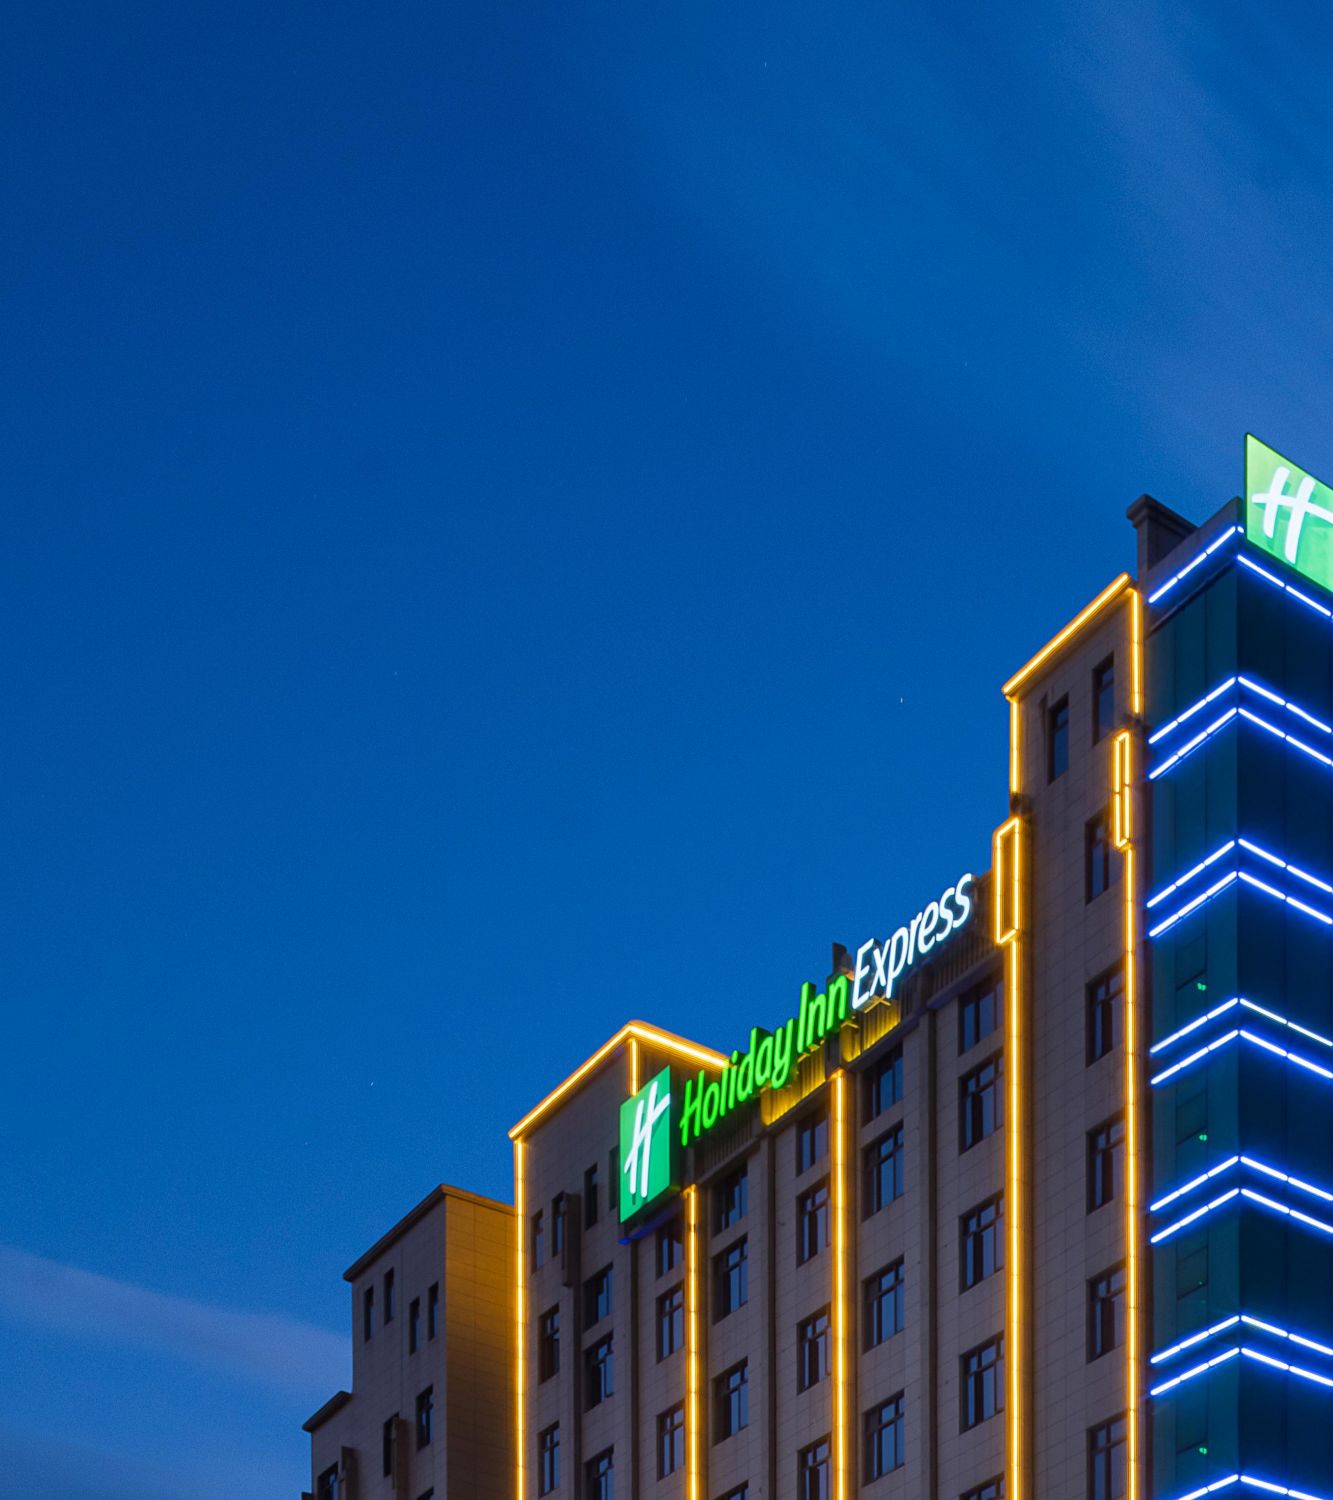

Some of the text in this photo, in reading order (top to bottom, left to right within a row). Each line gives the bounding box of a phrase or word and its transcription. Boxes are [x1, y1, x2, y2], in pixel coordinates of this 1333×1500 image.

[679, 873, 973, 1147] Holiday Inn Express
